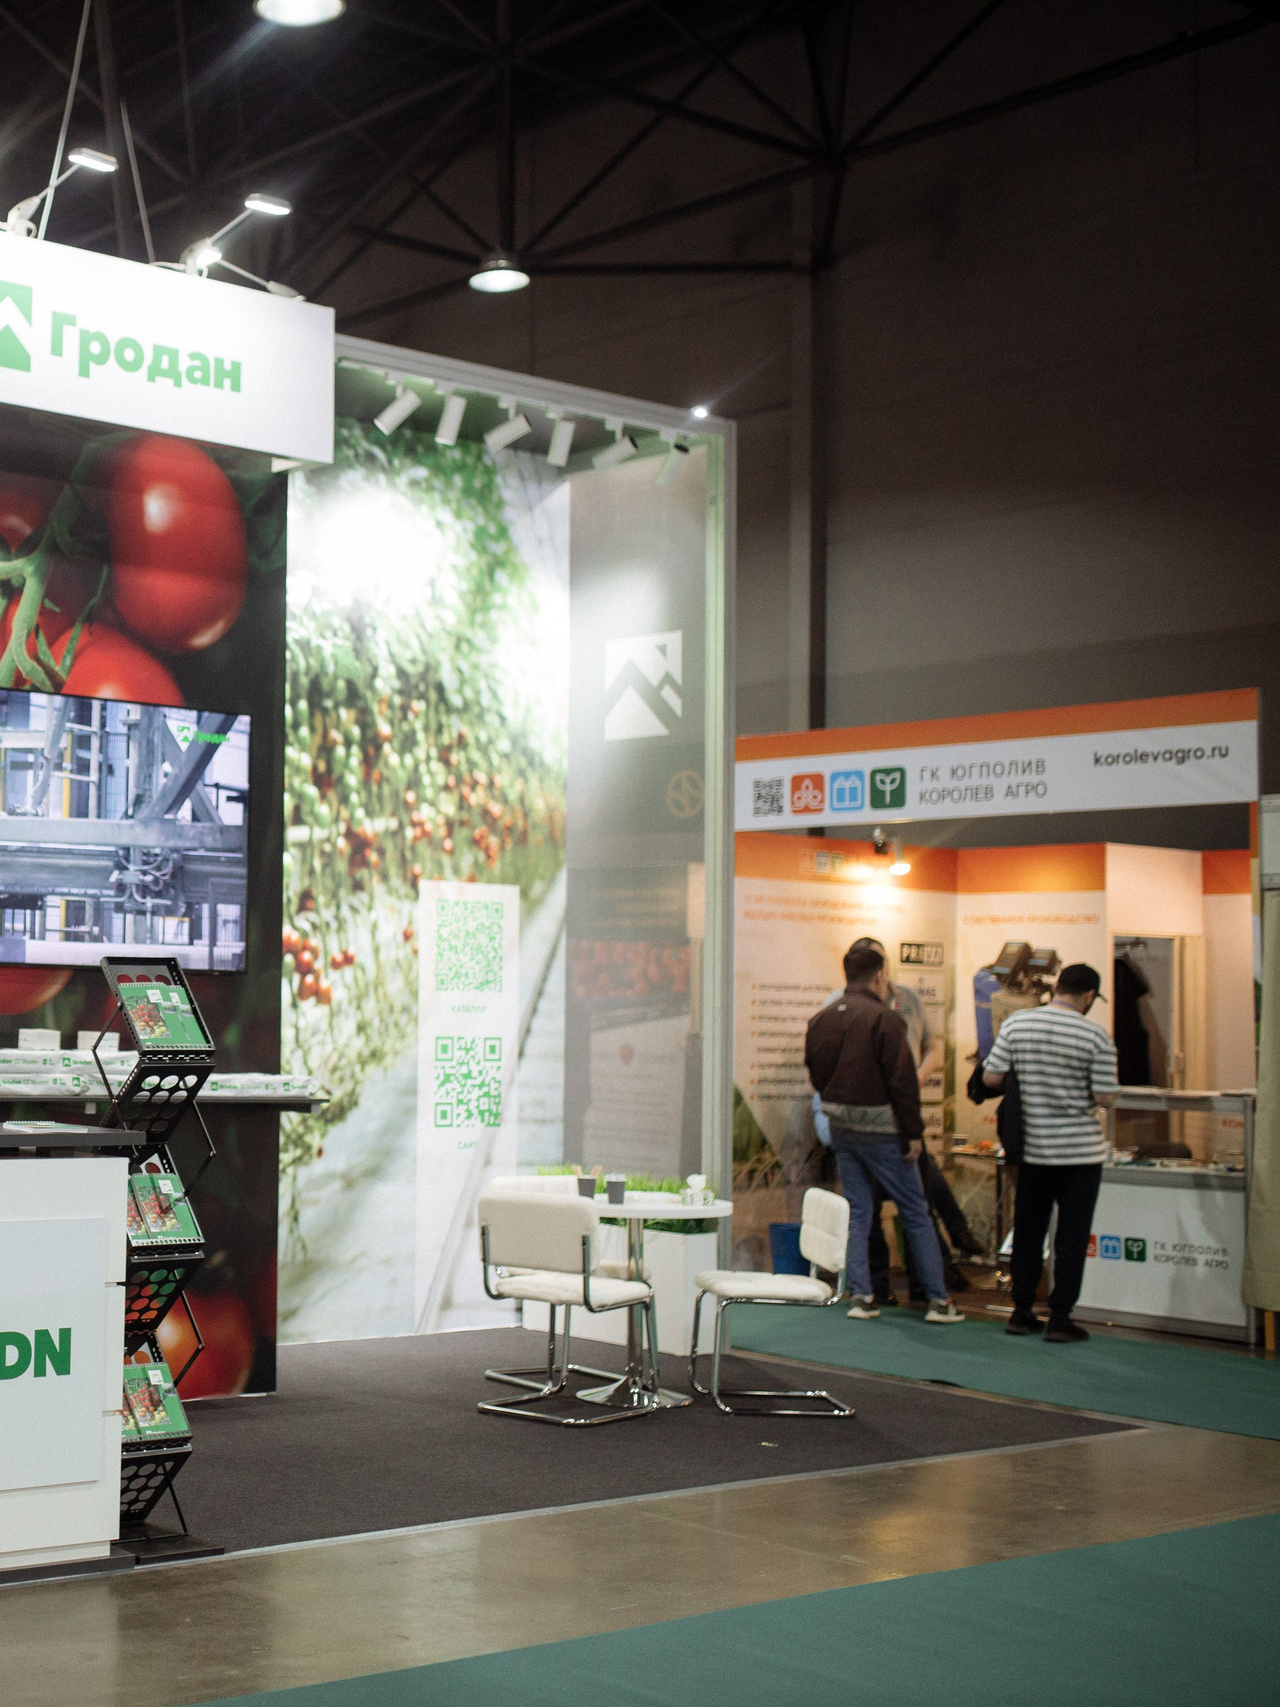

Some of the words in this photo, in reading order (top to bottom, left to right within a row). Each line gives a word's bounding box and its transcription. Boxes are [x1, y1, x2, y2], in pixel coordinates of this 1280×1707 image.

[50, 310, 242, 393] Гродан
[1093, 744, 1230, 767] korolevagro.ru
[919, 765, 940, 782] ГК
[949, 757, 1047, 781] ЮГПОЛИВ
[918, 783, 995, 806] КОРОЛЕВ
[1004, 781, 1048, 800] АГРО
